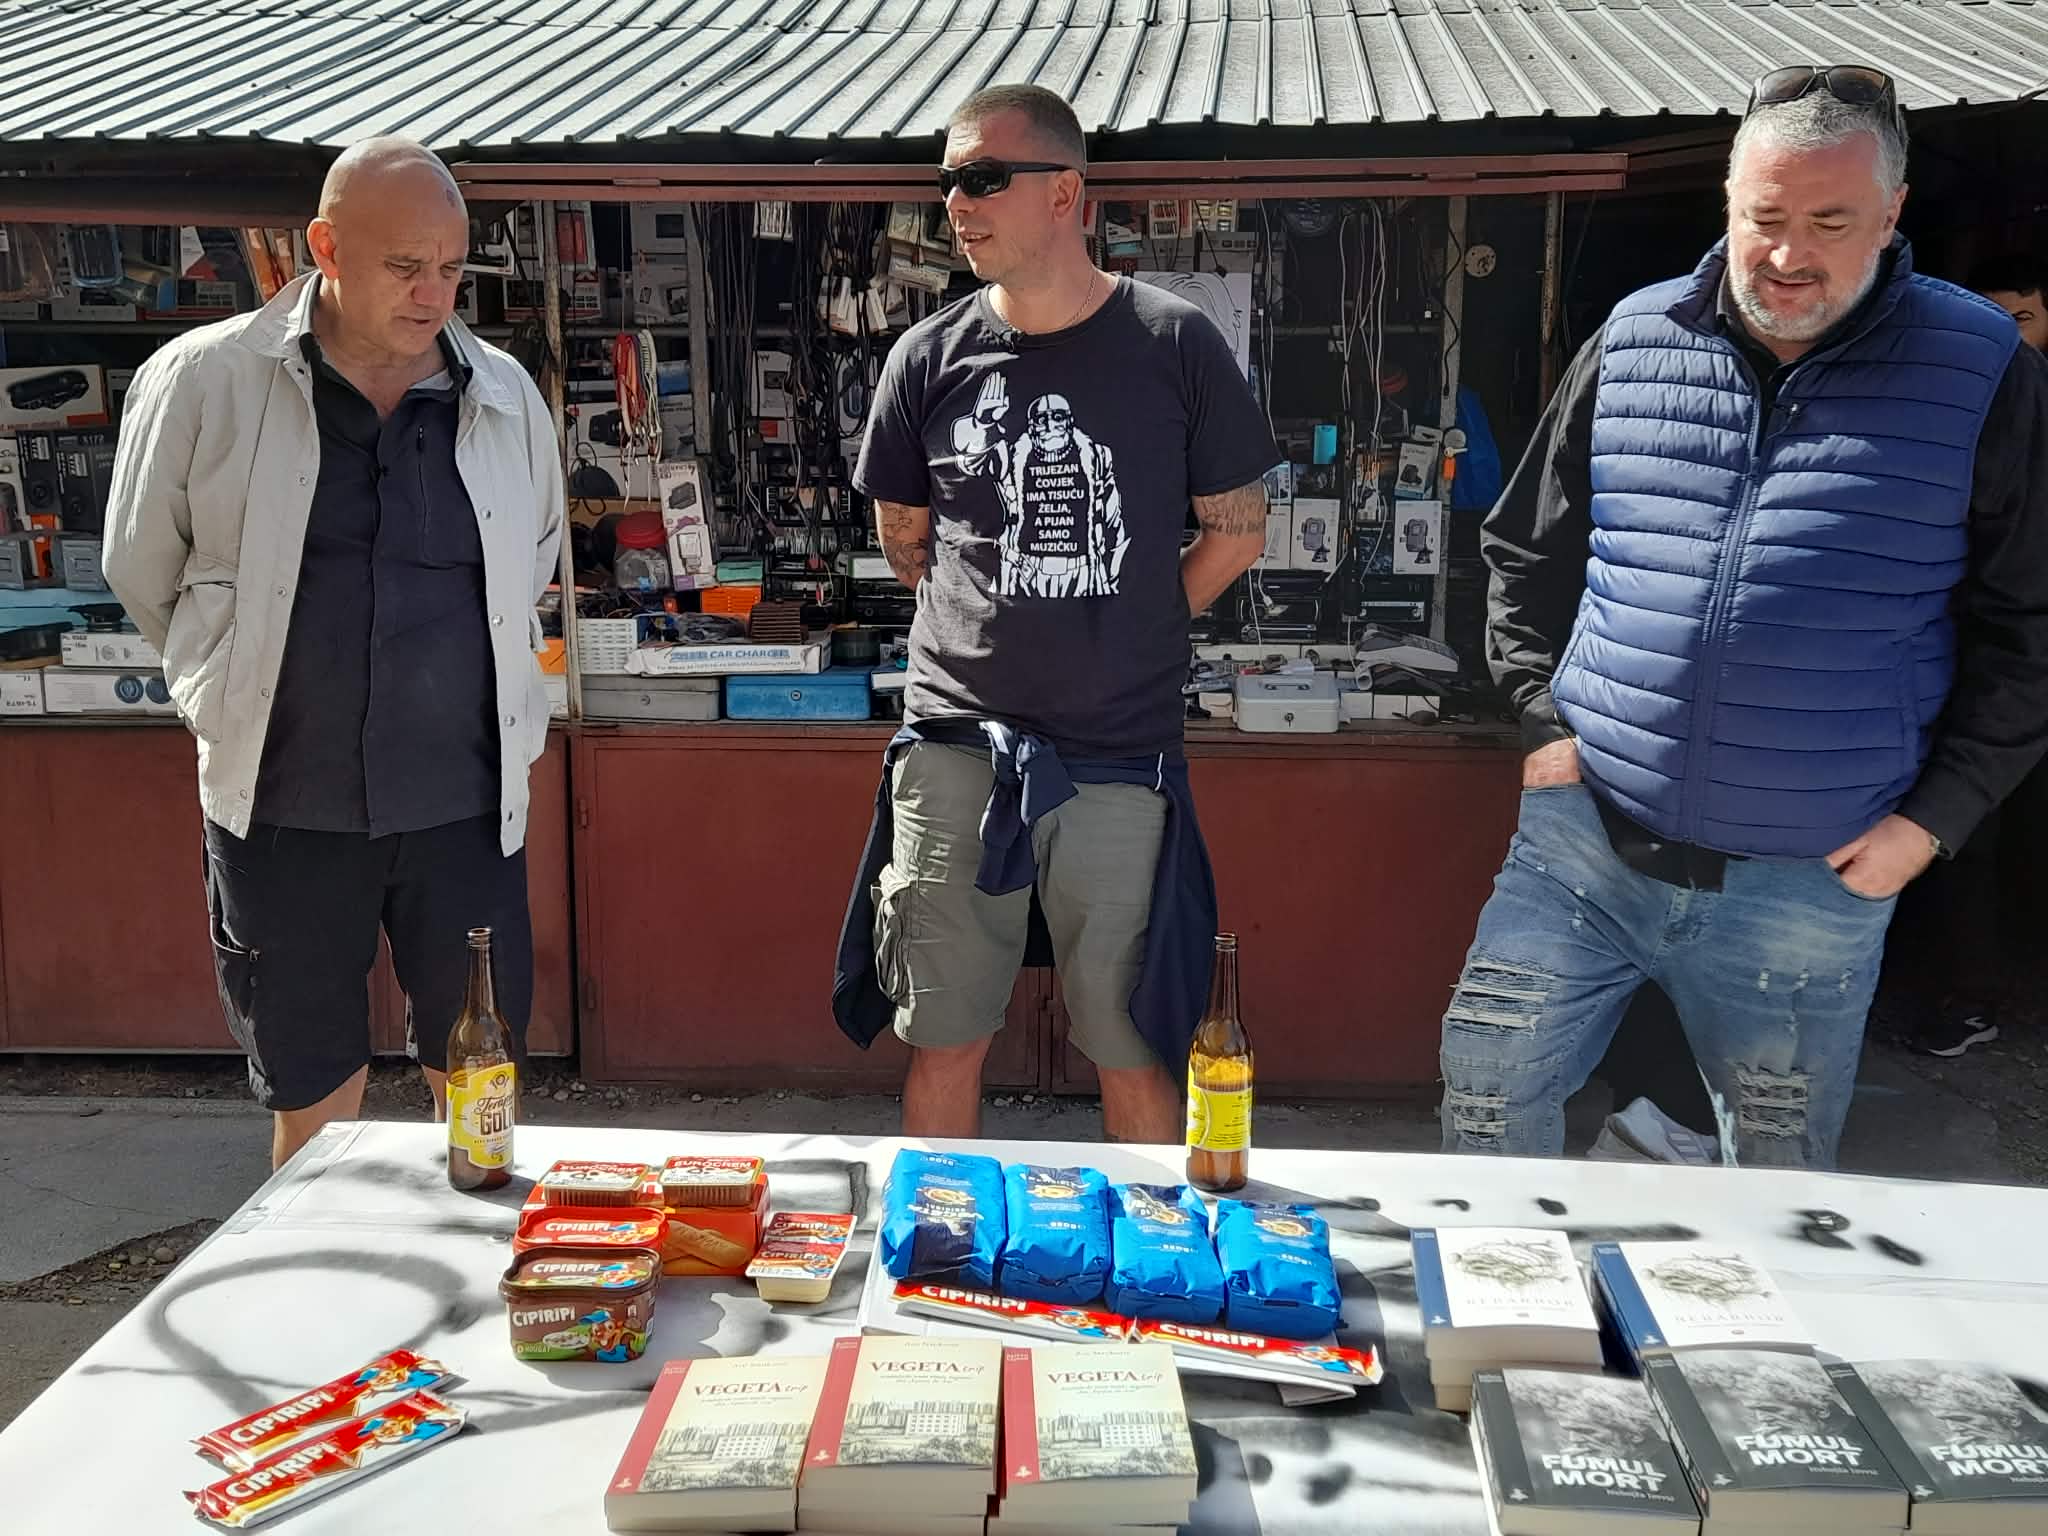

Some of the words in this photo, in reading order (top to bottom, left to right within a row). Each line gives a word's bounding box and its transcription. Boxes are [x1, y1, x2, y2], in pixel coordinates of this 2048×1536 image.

[1029, 464, 1079, 475] TRIJEZAN
[1035, 475, 1075, 488] ČOVJEK
[1026, 491, 1045, 501] IMA
[1037, 502, 1072, 514] ŽELJA,
[1034, 516, 1044, 526] A
[1045, 516, 1075, 526] PIJAN
[1038, 529, 1070, 539] SAMO
[1030, 540, 1078, 552] MUZIČKU
[709, 650, 733, 659] CAR
[674, 1159, 752, 1169] EUROCREM
[545, 1222, 610, 1231] CIPIRIPI
[532, 1263, 601, 1273] CIPIRIPI
[921, 1286, 1027, 1311] CIPIRIPI
[512, 1306, 576, 1327] CIPIRIPI
[1159, 1323, 1265, 1348] CIPIRIPI
[871, 1361, 961, 1372] VEGETA
[1047, 1371, 1140, 1384] VEGETA
[1140, 1373, 1164, 1384] trip
[693, 1381, 782, 1396] VEGETA
[230, 1391, 336, 1443] CIPIRIPI
[1749, 1450, 1862, 1467] MORT
[225, 1441, 337, 1498] CIPIRIPI
[1946, 1459, 2048, 1476] MOR
[1552, 1470, 1665, 1492] MORT
